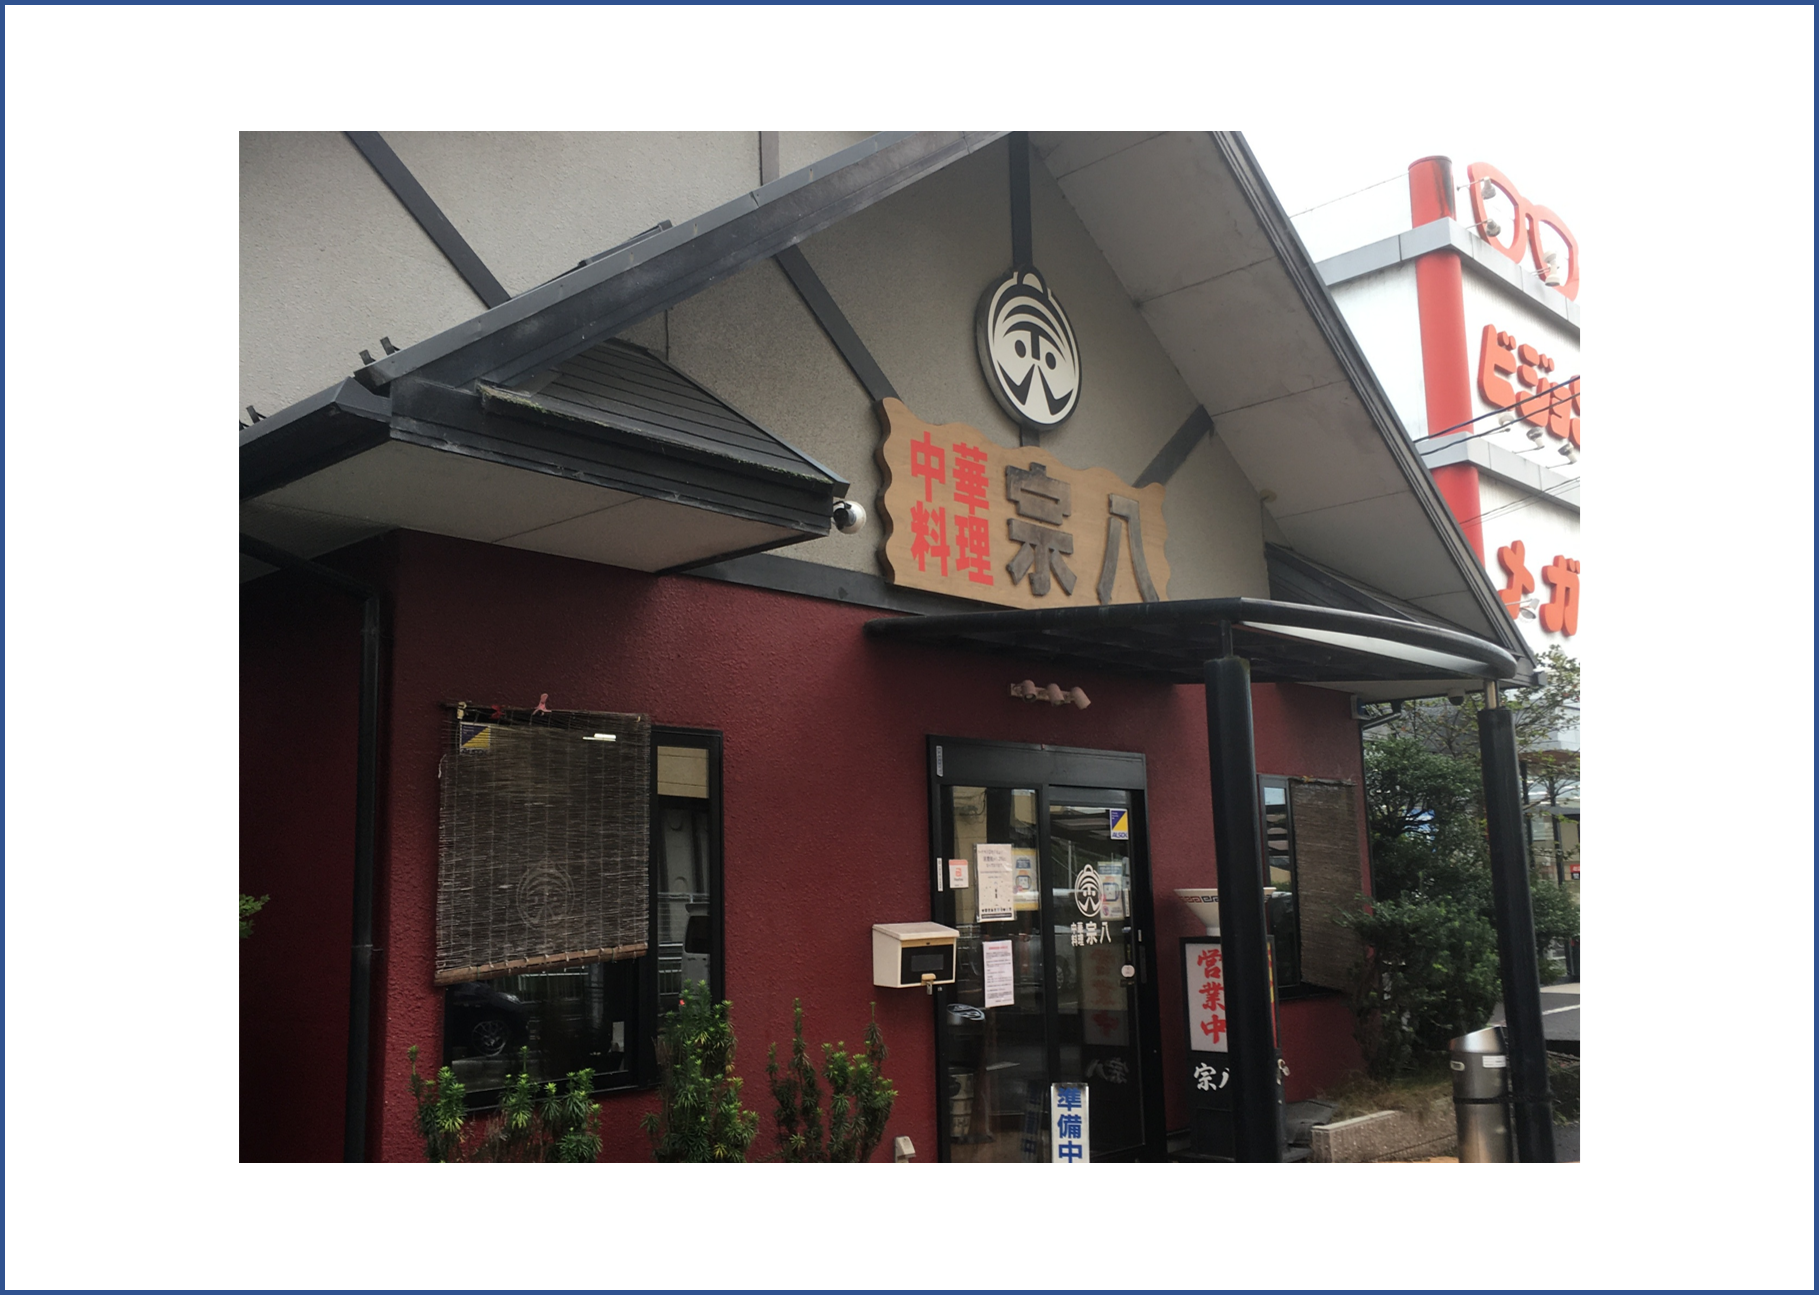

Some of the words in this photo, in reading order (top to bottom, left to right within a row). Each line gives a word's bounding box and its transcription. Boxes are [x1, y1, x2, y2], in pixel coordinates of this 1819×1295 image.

[910, 430, 989, 515] 中華
[910, 500, 994, 587] 料理
[1005, 461, 1161, 606] 宗八
[1085, 920, 1112, 945] 宗八
[1197, 948, 1227, 1045] 営業中
[1057, 1086, 1083, 1163] 準備中
